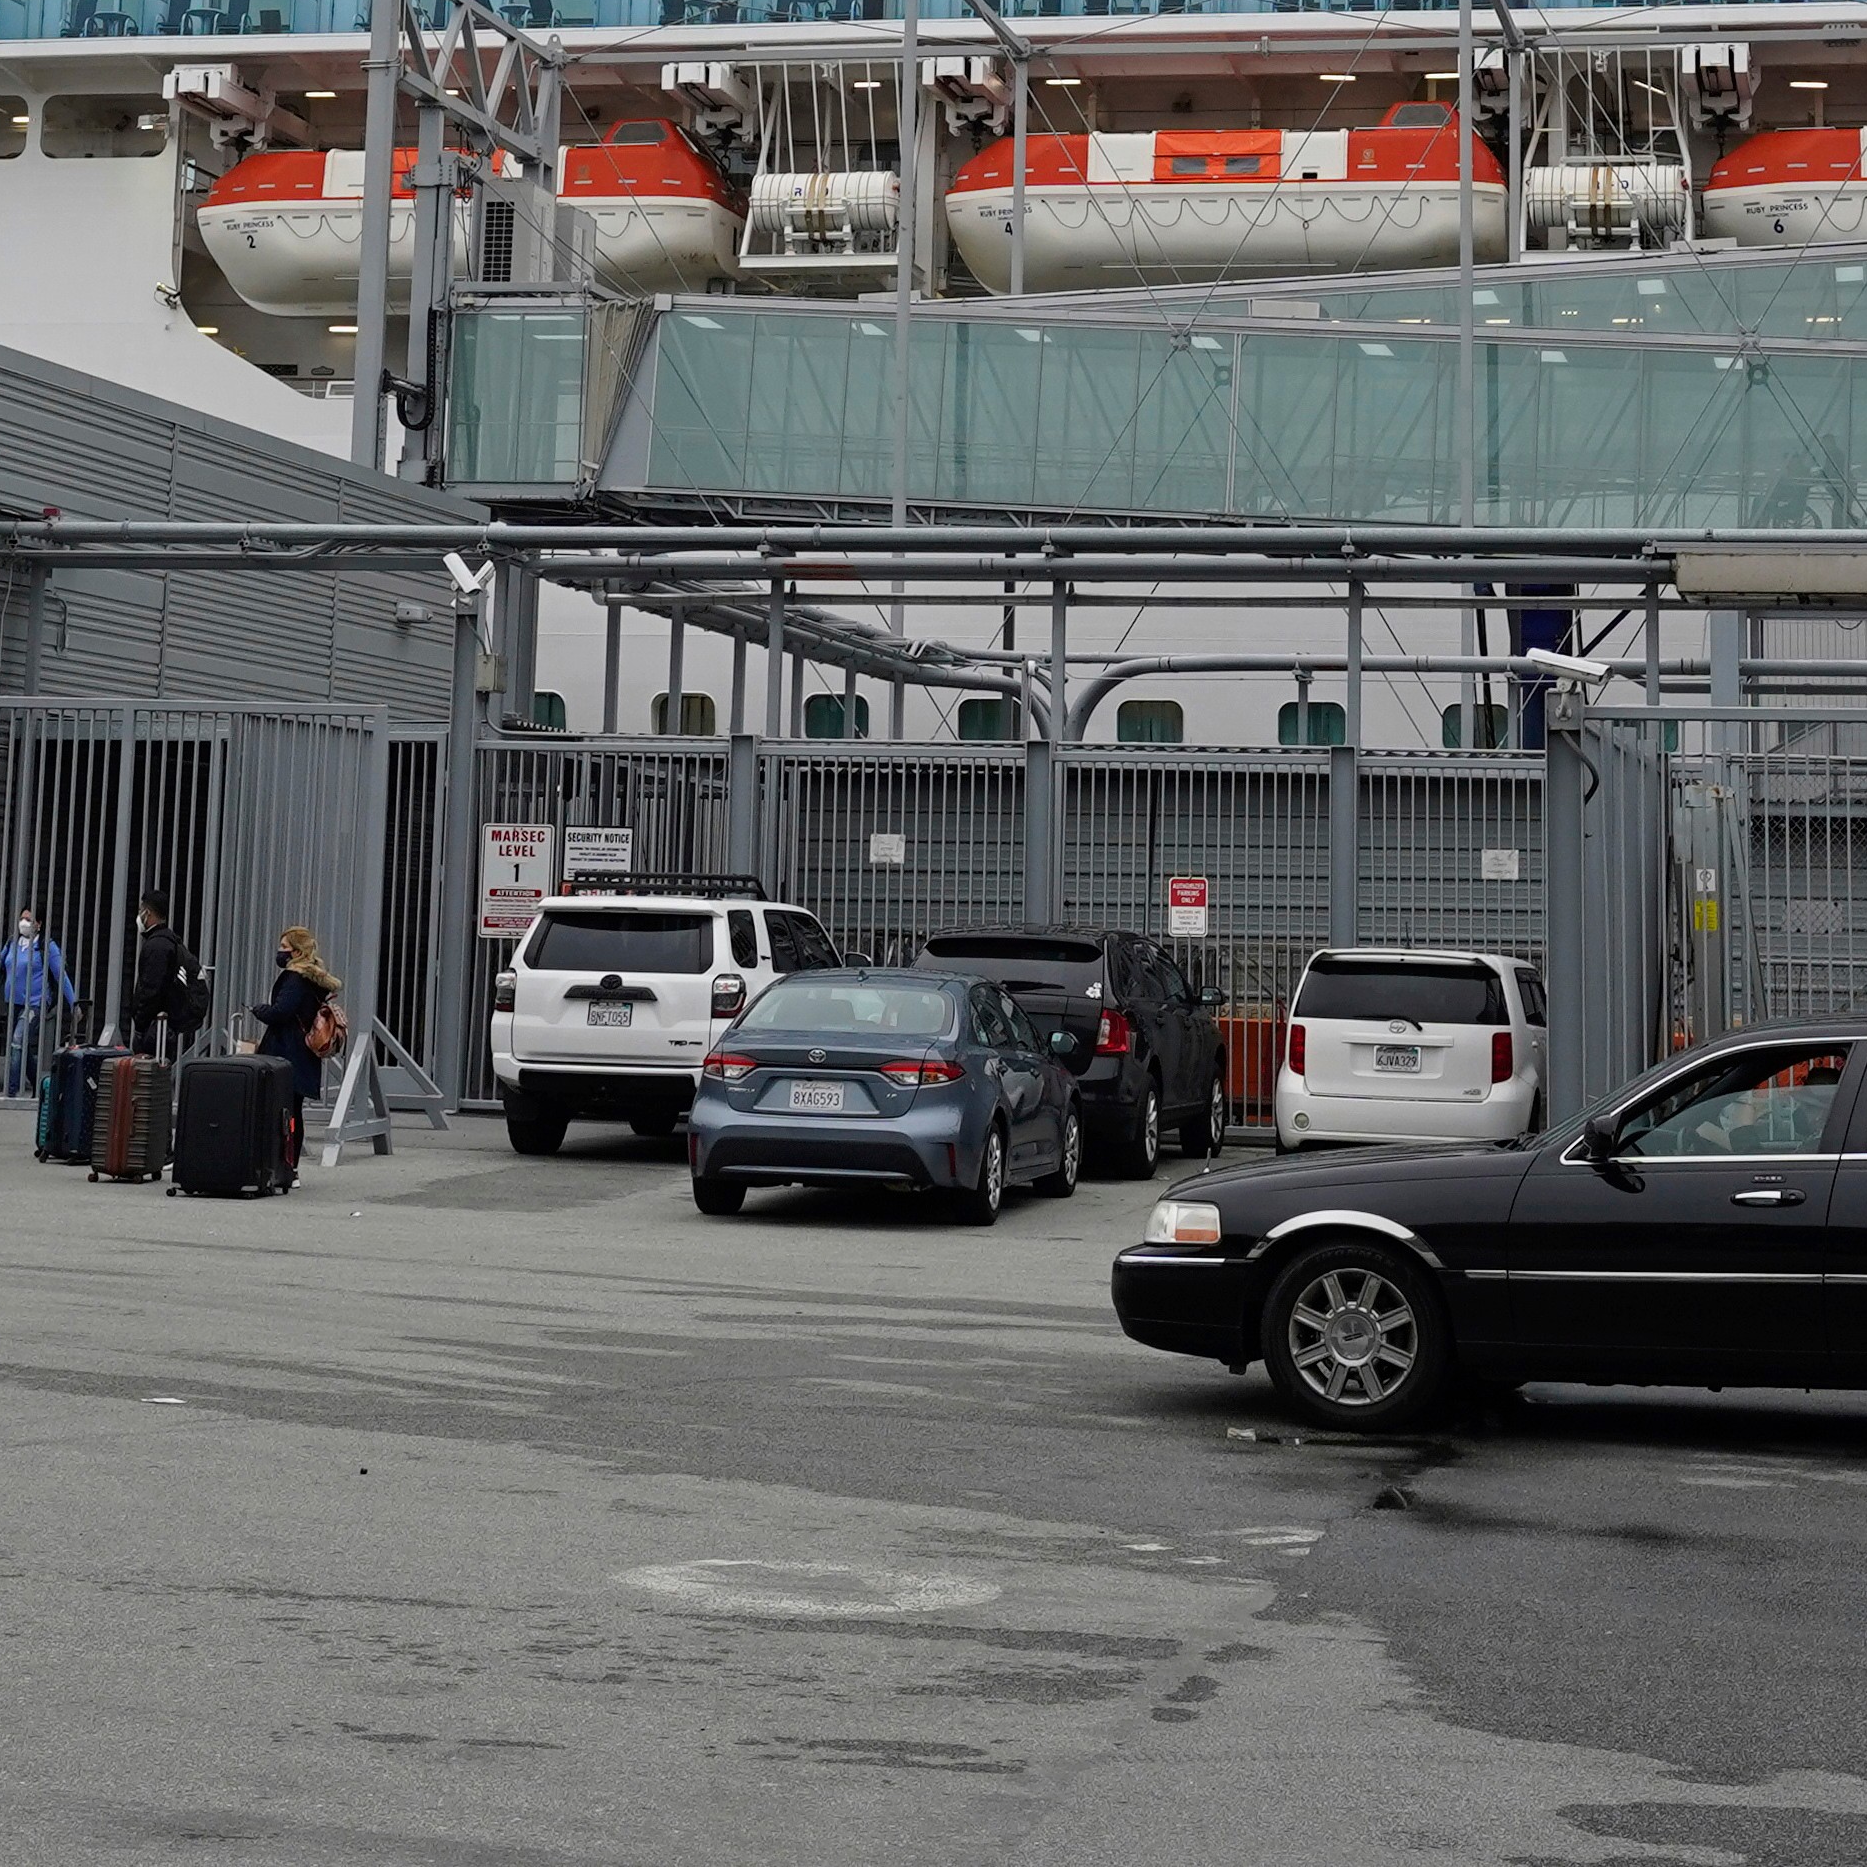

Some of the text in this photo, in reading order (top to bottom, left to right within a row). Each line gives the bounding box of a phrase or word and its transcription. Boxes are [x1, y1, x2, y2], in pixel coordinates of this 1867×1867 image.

[1746, 202, 1809, 215] RUBY PRINCESS
[1004, 221, 1013, 236] 4
[1773, 218, 1785, 234] 6
[246, 234, 257, 249] 2
[491, 830, 546, 843] MARSEC
[567, 832, 630, 844] SECURITY NOTICE
[499, 844, 536, 857] LEVEL
[513, 863, 520, 883] 1
[1376, 1055, 1417, 1067] 6JVA329
[793, 1091, 840, 1106] 8XAG593
